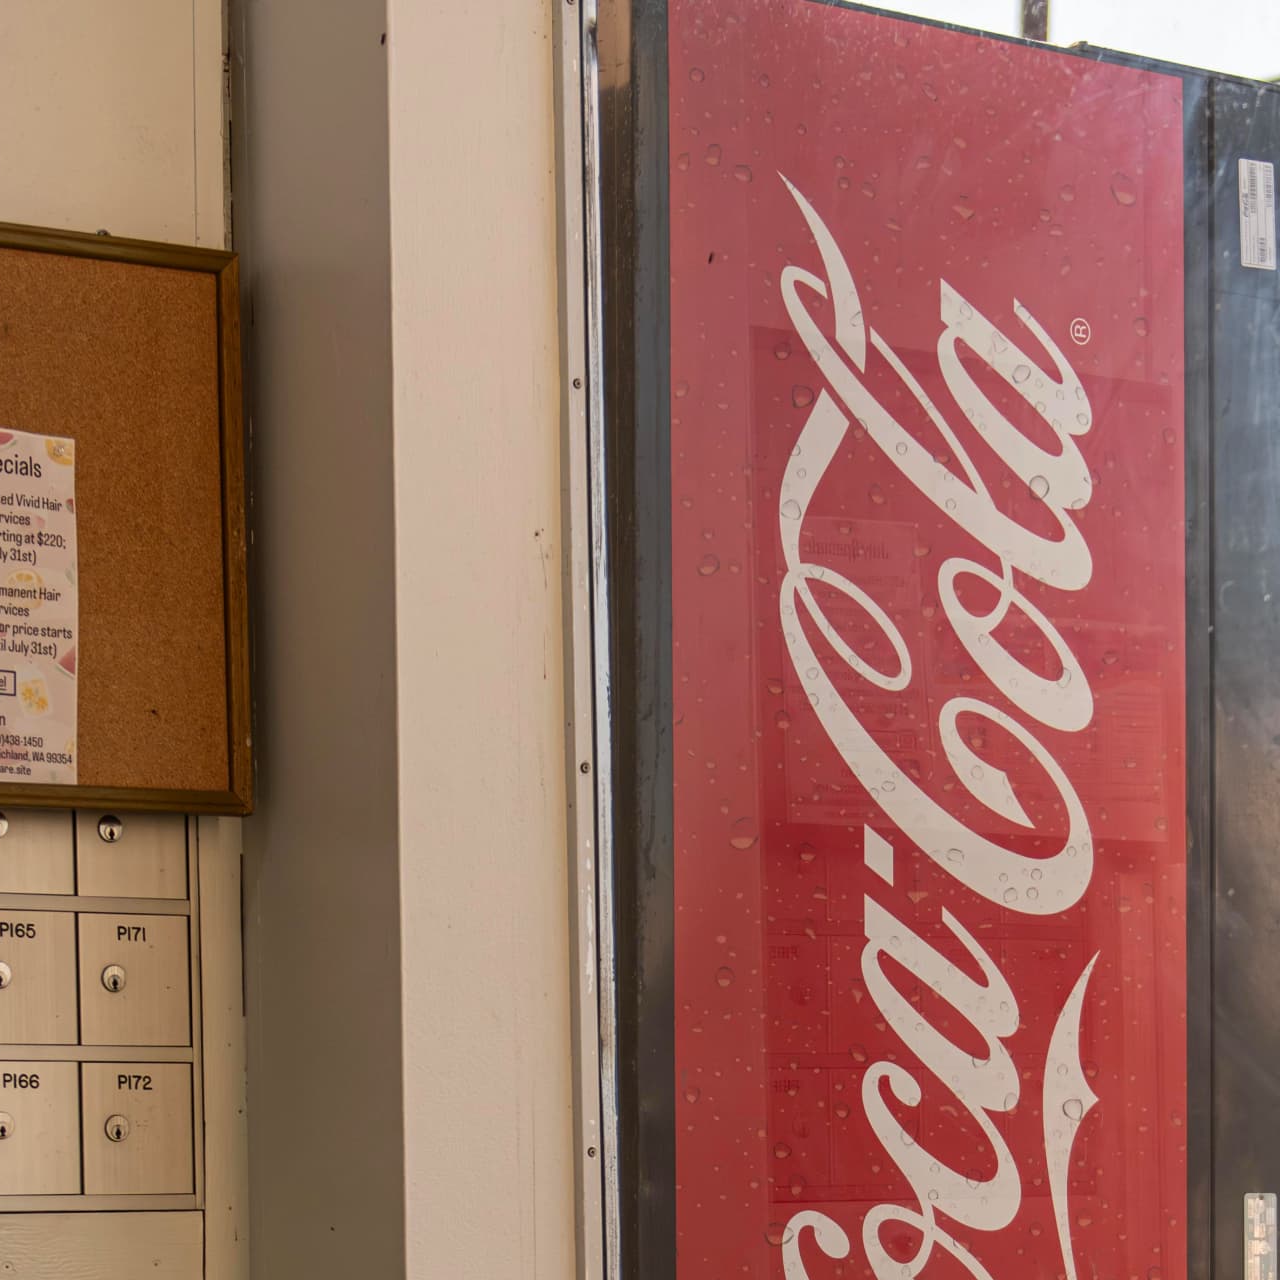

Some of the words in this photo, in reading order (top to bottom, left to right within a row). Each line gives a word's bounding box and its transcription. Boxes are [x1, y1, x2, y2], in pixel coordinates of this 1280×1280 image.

[16, 493, 40, 509] Vivid
[42, 496, 62, 512] Hair
[24, 534, 35, 544] at
[37, 531, 66, 549] $220;
[10, 548, 37, 566] 31st)
[39, 587, 62, 602] Hair
[12, 622, 39, 638] price
[40, 626, 73, 640] starts
[8, 639, 30, 657] July
[31, 641, 57, 660] 31st)
[32, 751, 46, 762] WA
